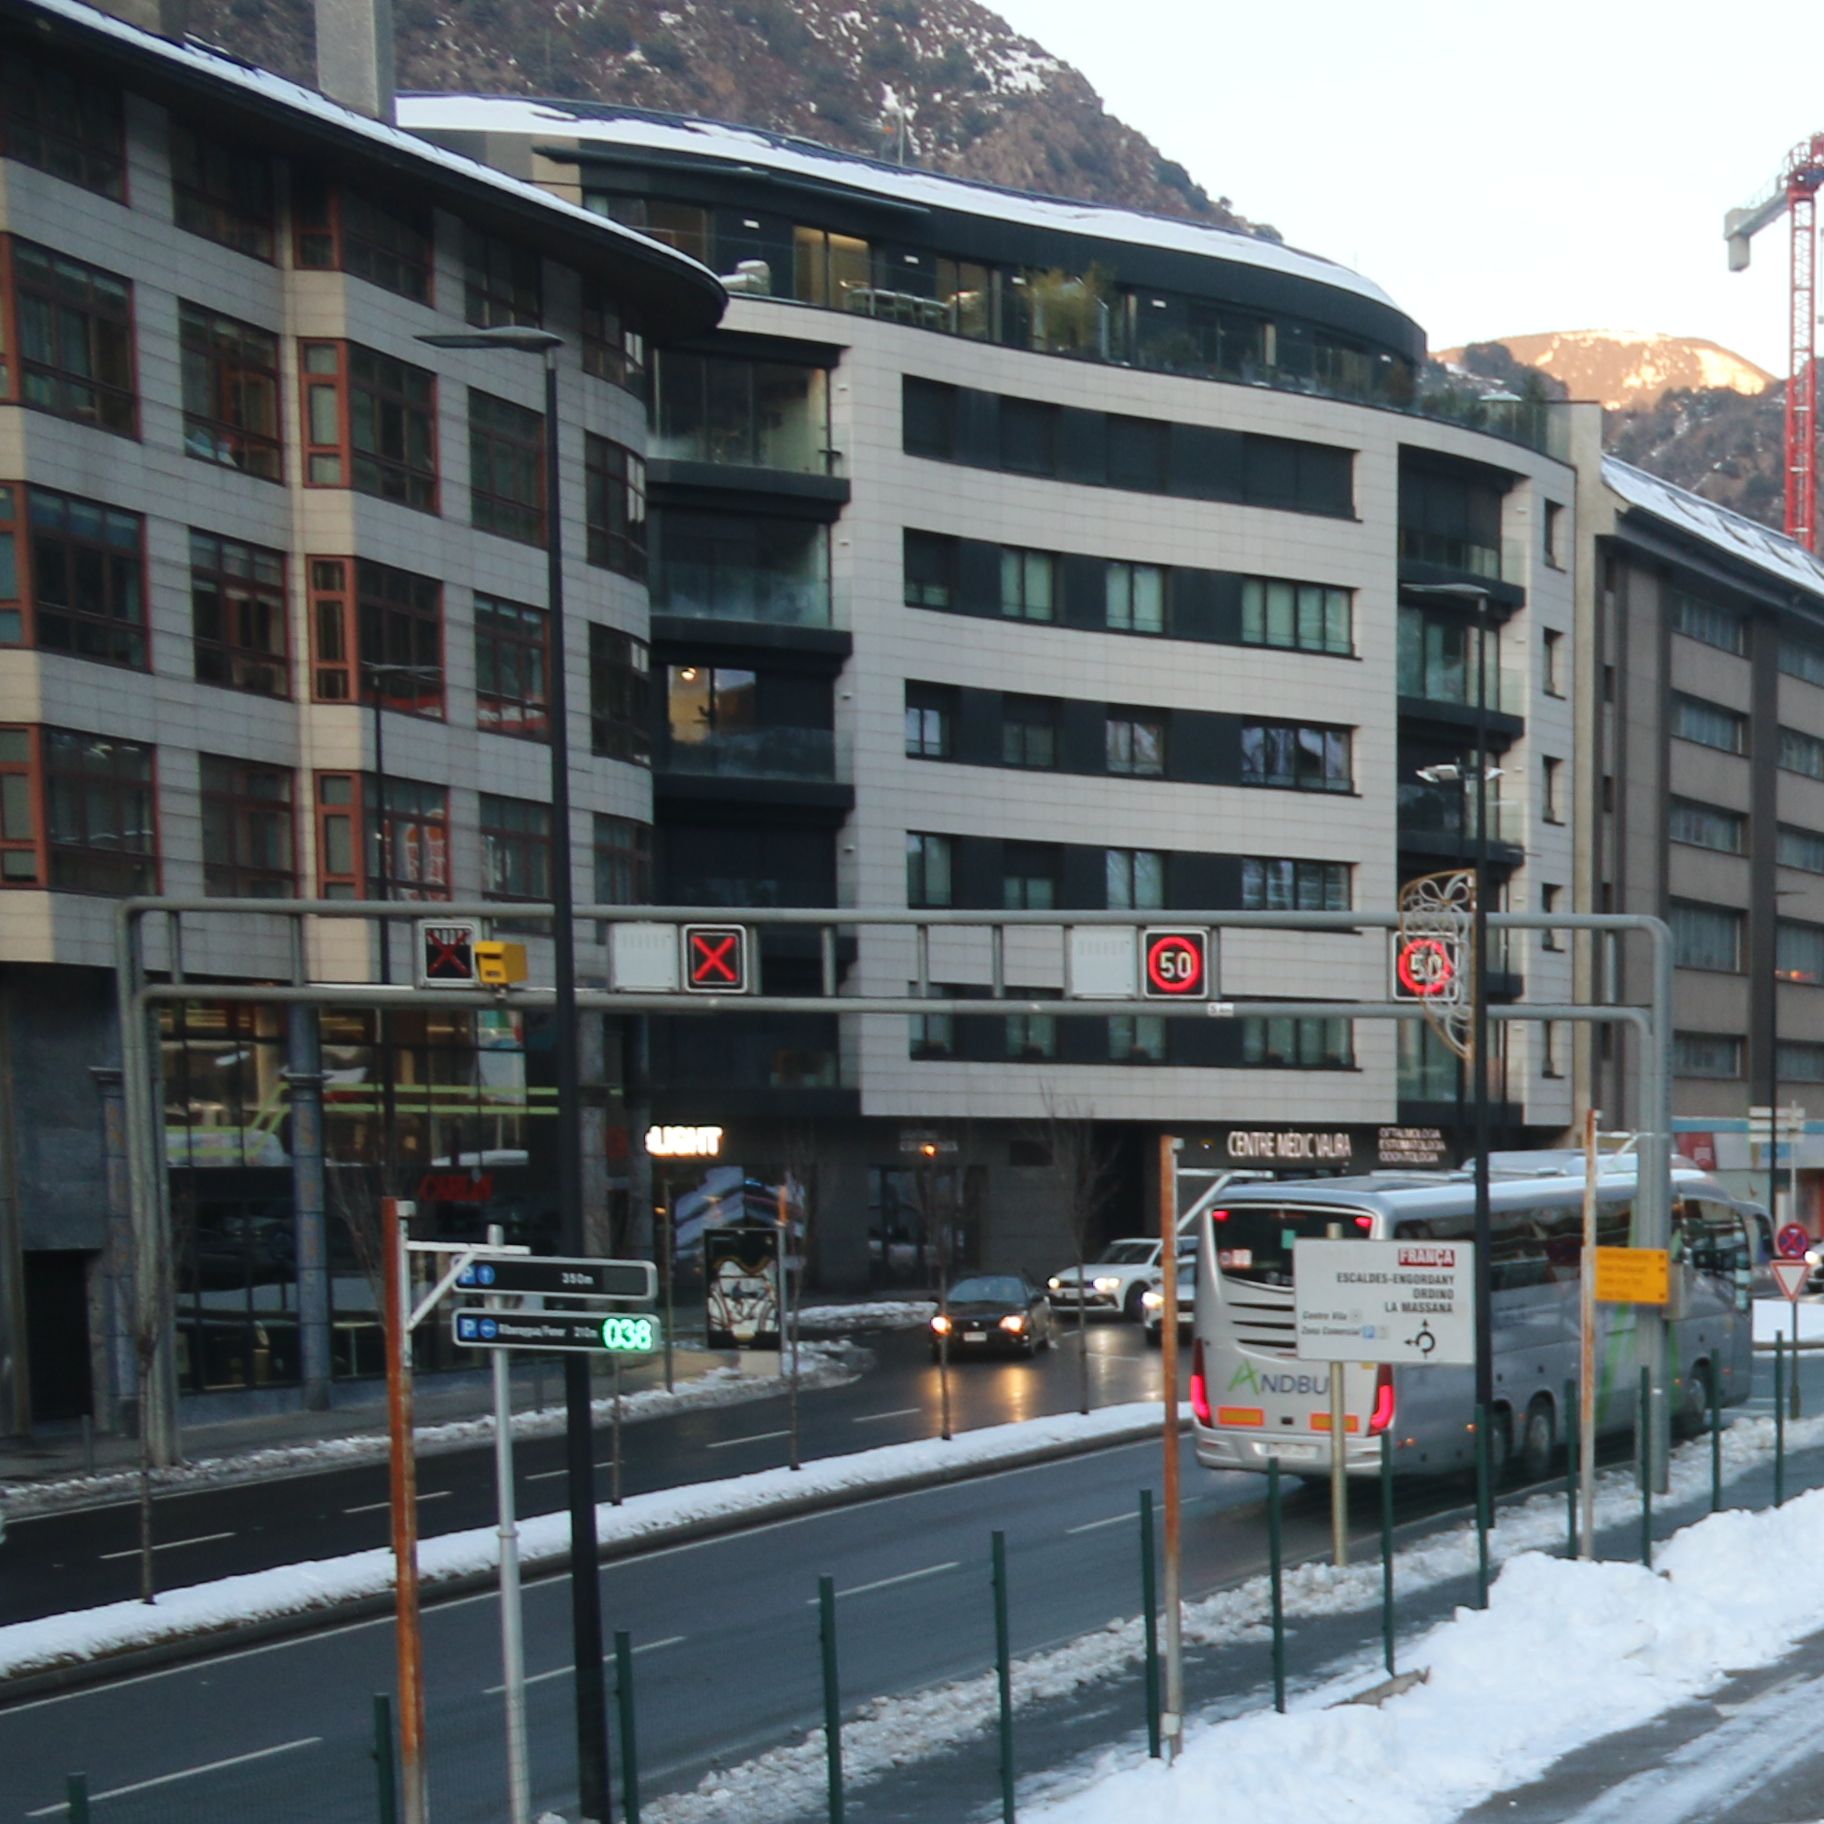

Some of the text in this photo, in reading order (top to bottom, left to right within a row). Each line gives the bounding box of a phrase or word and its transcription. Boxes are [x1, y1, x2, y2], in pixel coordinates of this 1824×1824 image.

[1159, 951, 1192, 979] 50
[1409, 954, 1442, 982] 50
[1227, 1131, 1275, 1158] CENTRE
[1401, 1249, 1454, 1267] FRANÇA
[561, 1272, 594, 1285] 350m
[1337, 1271, 1455, 1286] ESCALDES-ENGORDANY
[1413, 1288, 1454, 1300] ORDINO
[1384, 1302, 1454, 1314] LA MASSANA
[602, 1317, 652, 1350] 038
[1227, 1359, 1332, 1397] ANDBU
